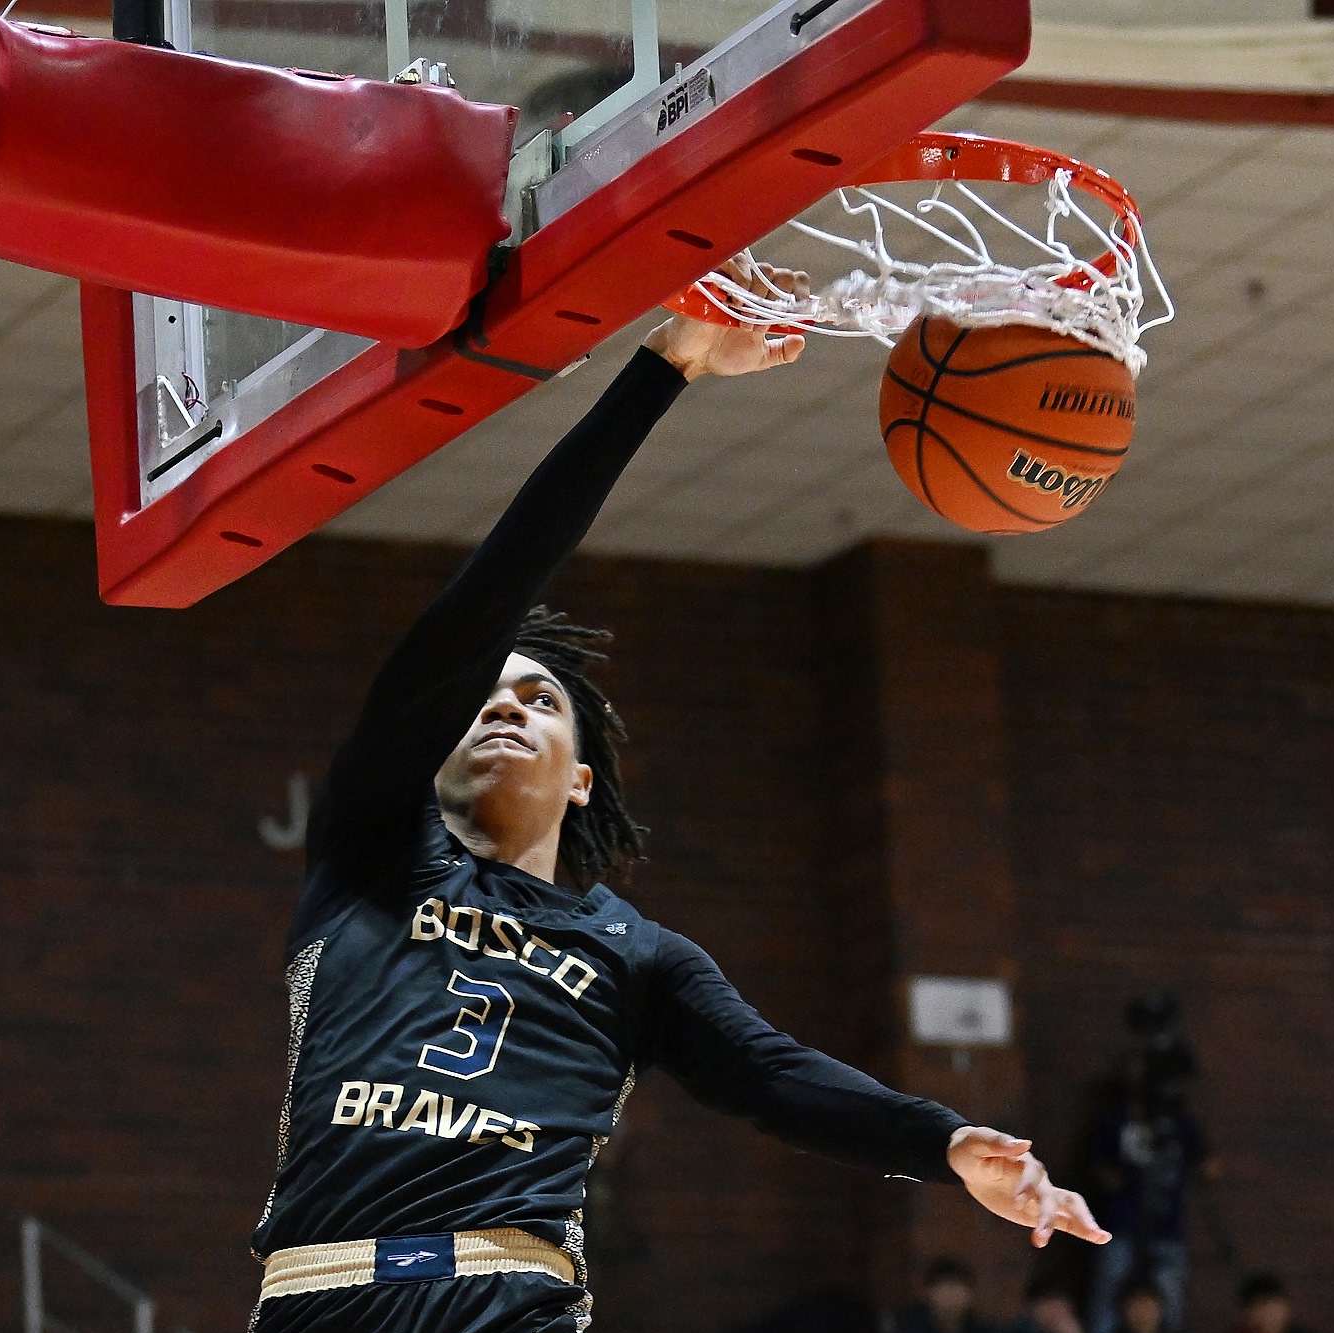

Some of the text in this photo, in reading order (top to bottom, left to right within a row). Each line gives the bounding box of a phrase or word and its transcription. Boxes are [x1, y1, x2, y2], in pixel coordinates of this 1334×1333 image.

[1007, 448, 1121, 509] ilson
[259, 773, 308, 849] J
[410, 898, 598, 1000] BOSCO
[417, 970, 515, 1080] 3
[331, 1080, 542, 1153] BRAVES
